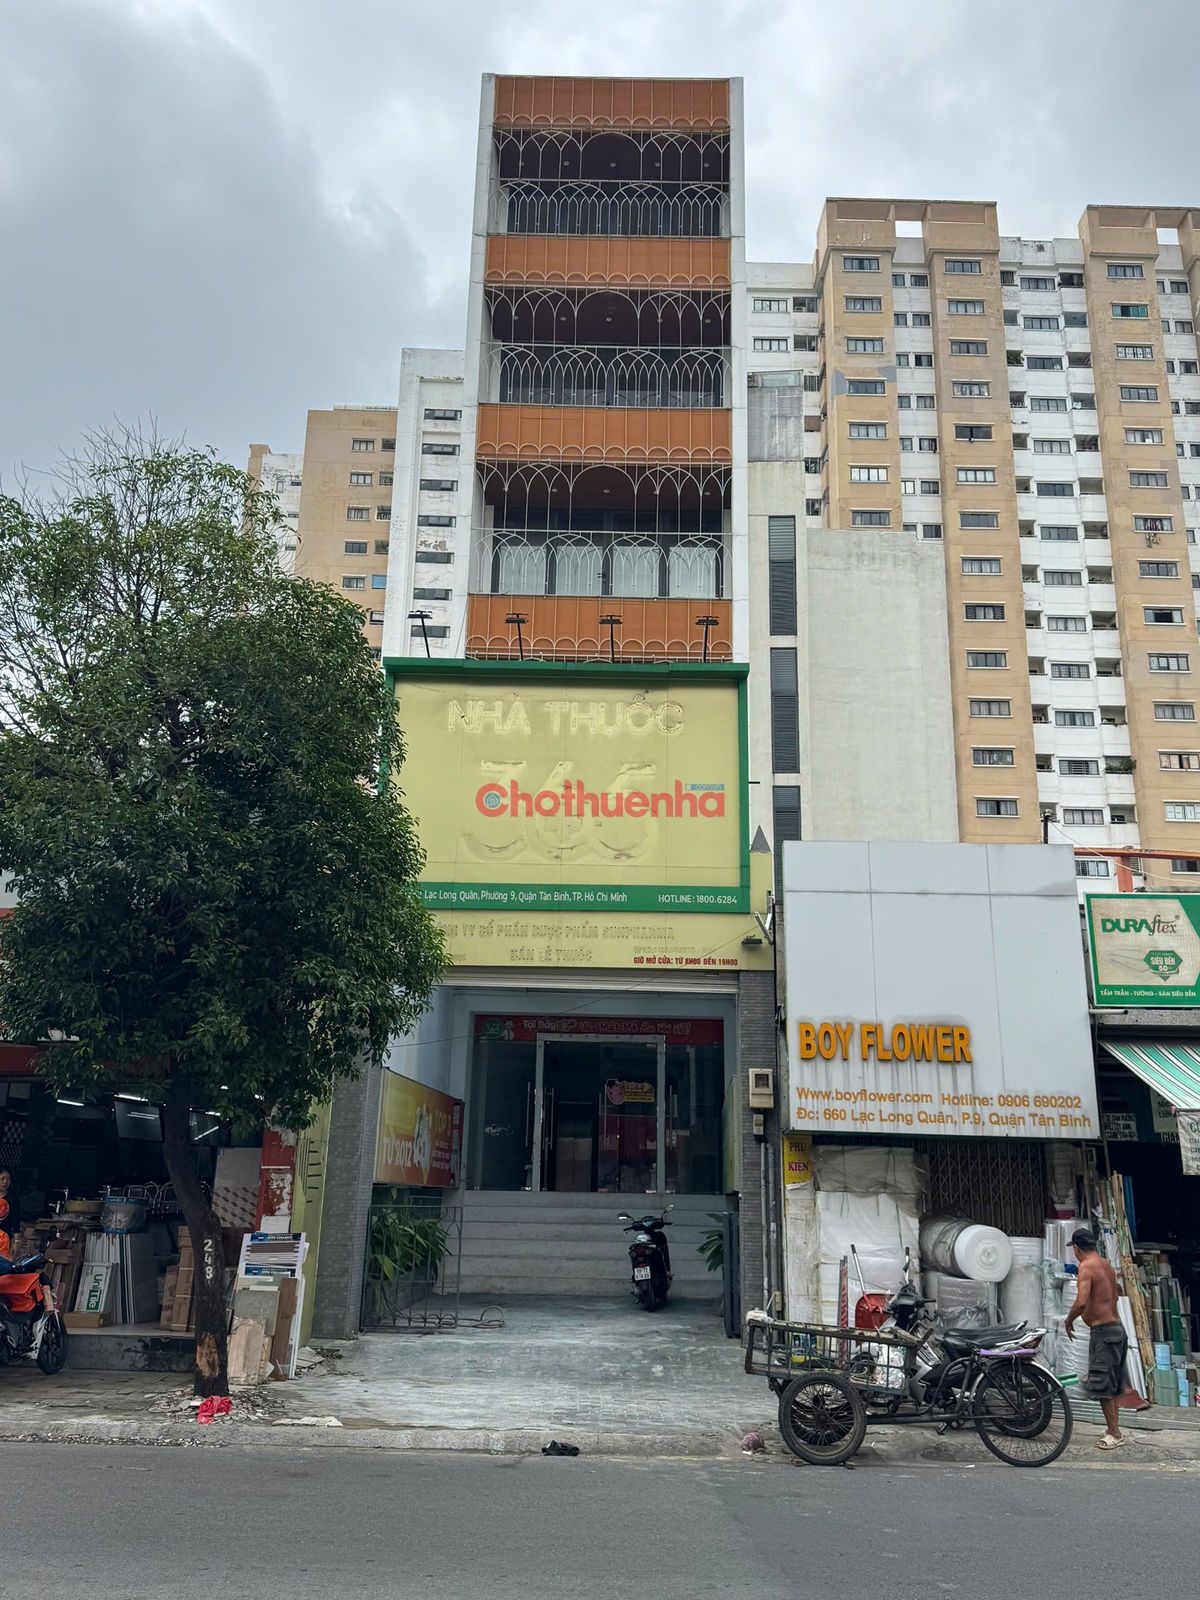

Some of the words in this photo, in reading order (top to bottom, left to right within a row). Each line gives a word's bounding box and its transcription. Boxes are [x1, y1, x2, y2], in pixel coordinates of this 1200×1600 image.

[449, 692, 532, 735] NHÀ
[543, 689, 686, 735] THUỐC
[439, 890, 457, 901] Long
[596, 892, 609, 901] Chí
[799, 1023, 853, 1060] BOY
[860, 1023, 973, 1063] FLOWER
[941, 1093, 993, 1106] Hotline:
[997, 1094, 1030, 1108] 0906
[1033, 1095, 1081, 1109] 690202
[796, 1107, 820, 1120] Đc:
[823, 1108, 847, 1121] 660
[851, 1109, 876, 1124] Lạc
[879, 1109, 913, 1125] Long
[988, 1112, 1025, 1128] Quận
[1028, 1113, 1055, 1127] Tân
[1059, 1114, 1091, 1128] Bình
